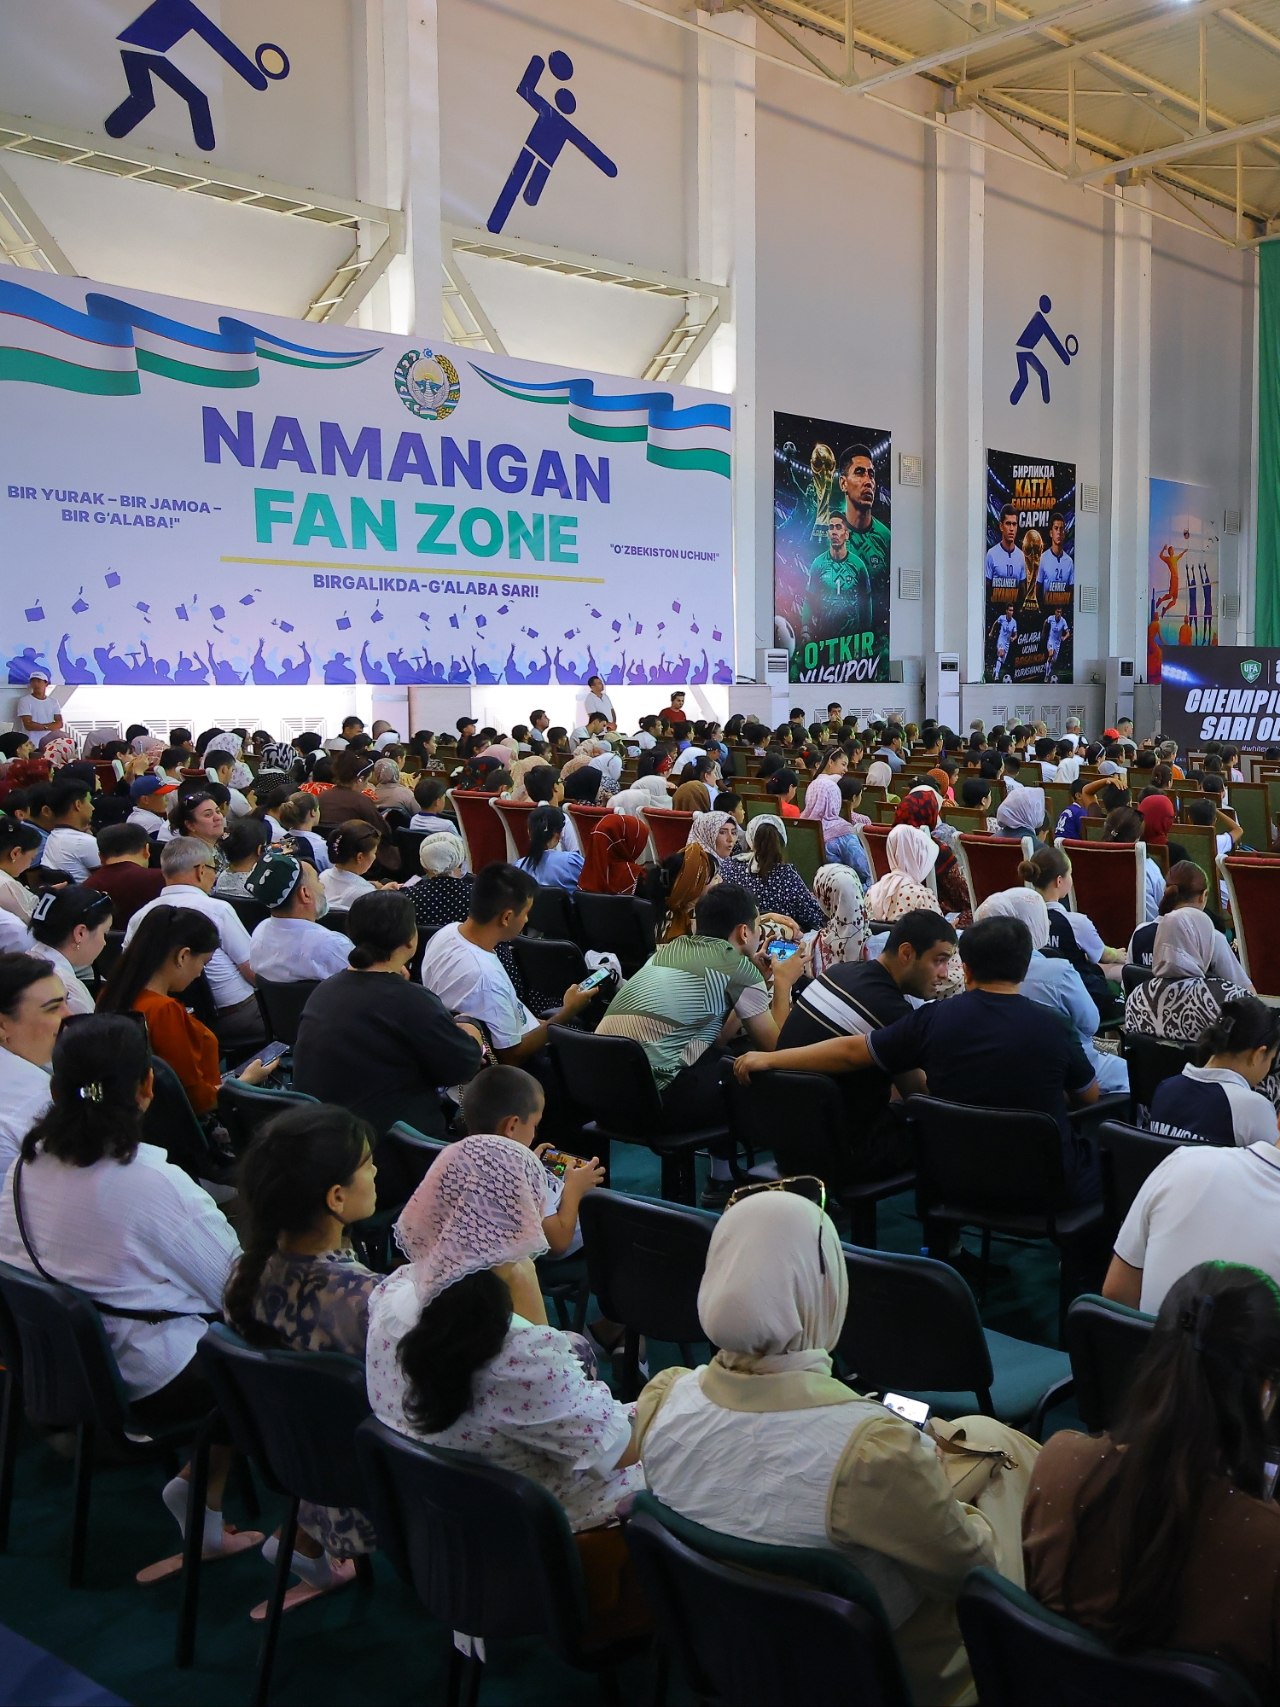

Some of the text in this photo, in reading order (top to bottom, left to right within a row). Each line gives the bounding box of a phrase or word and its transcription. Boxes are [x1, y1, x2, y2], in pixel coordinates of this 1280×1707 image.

[202, 405, 611, 504] NAMANGAN
[1012, 465, 1055, 479] БИРЛИКДА
[1015, 478, 1053, 497] КАТТА
[7, 485, 37, 500] BIR
[41, 488, 105, 505] YURAK
[120, 495, 147, 509] BIR
[150, 498, 211, 514] JAMOA
[61, 509, 90, 523] BIR
[1019, 511, 1050, 528] САРИ!
[254, 487, 579, 564] FAN ZONE
[501, 583, 539, 598] SARI!
[1244, 663, 1258, 672] UFA
[1200, 716, 1257, 741] SARI
